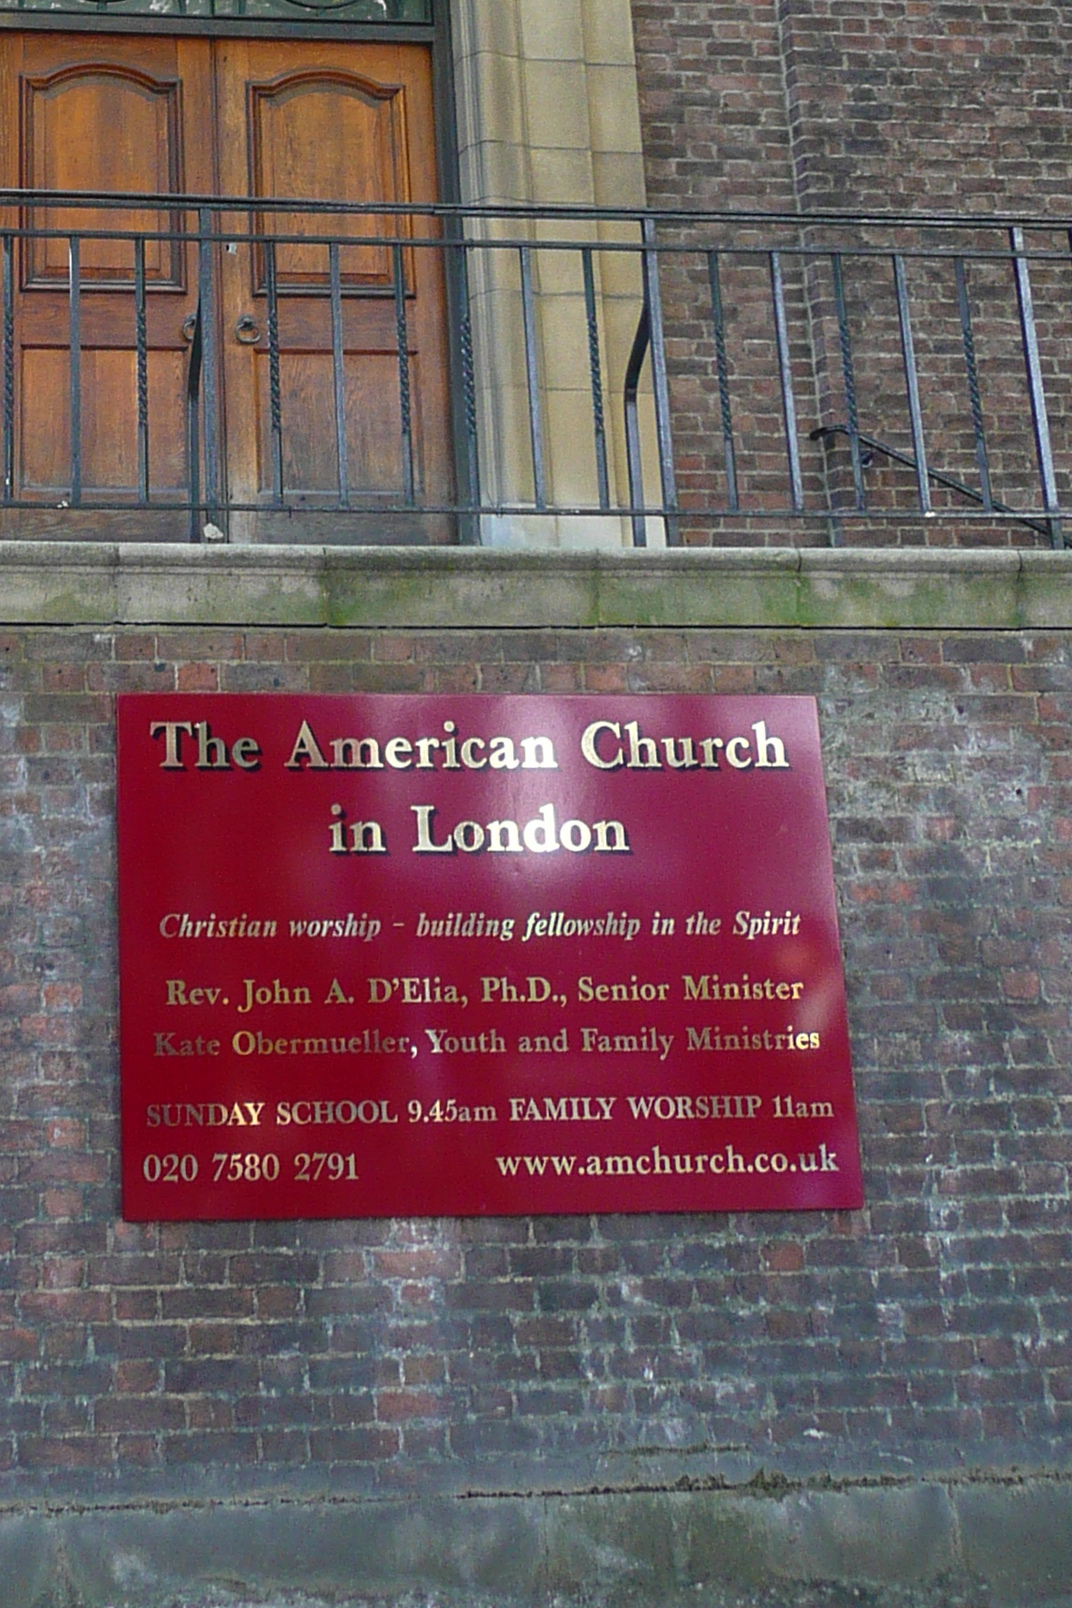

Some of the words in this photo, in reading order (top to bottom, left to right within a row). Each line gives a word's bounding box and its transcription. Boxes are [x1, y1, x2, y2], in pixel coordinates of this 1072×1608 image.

[150, 720, 260, 770] The
[284, 720, 560, 770] American
[581, 720, 790, 770] Church
[329, 803, 387, 853] in
[410, 803, 631, 853] London
[159, 913, 277, 938] Christian
[289, 912, 381, 942] worship
[416, 912, 515, 941] building
[522, 911, 641, 942] fellowship
[652, 911, 675, 936] in
[686, 911, 721, 936] the
[733, 910, 801, 940] Spirit
[165, 979, 229, 1005] Rev.
[237, 978, 312, 1013] John
[324, 978, 354, 1004] A.
[367, 976, 468, 1008] D'Elia,
[480, 976, 568, 1007] Ph.D.,
[578, 975, 670, 1002] Senior
[682, 974, 804, 1001] Minister
[153, 1032, 220, 1056] Kate
[232, 1029, 418, 1059] Obermueller,
[425, 1029, 507, 1054] Youth
[518, 1028, 569, 1053] and
[580, 1026, 674, 1060] Family
[686, 1025, 821, 1051] Ministries
[146, 1102, 265, 1127] SUNDAY
[276, 1100, 398, 1125] SCHOOL
[408, 1098, 498, 1123] 9.45am
[508, 1096, 617, 1122] FAMILY
[626, 1095, 762, 1120] WORSHIP
[772, 1094, 835, 1119] 11am
[143, 1154, 198, 1182] 020
[212, 1153, 280, 1182] 7580
[294, 1152, 359, 1181] 2791
[495, 1144, 839, 1177] www.amchurch.co.uk
